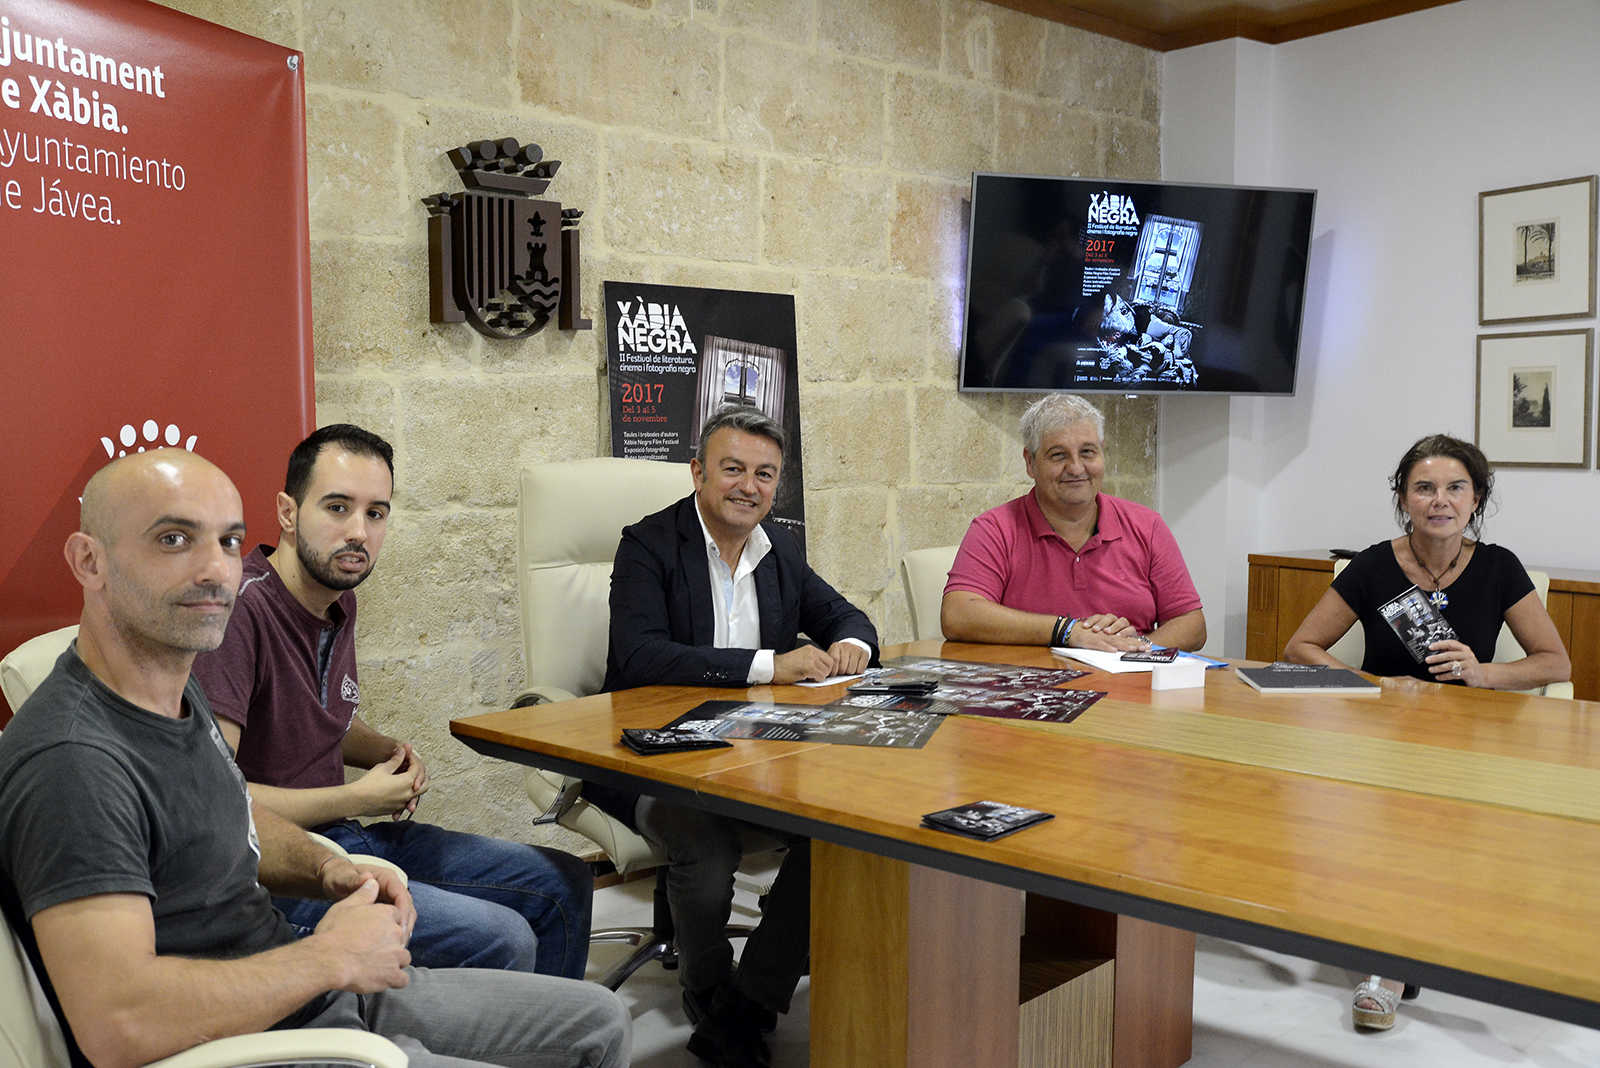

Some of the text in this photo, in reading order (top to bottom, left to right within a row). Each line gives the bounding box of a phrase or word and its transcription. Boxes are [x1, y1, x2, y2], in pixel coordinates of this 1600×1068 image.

[28, 75, 129, 134] Xàbia.
[0, 128, 186, 191] yuntamiento
[33, 176, 122, 225] Jávea.
[1088, 190, 1136, 211] XÀBIA
[1087, 208, 1140, 225] NEGRA
[1086, 239, 1115, 252] 2017
[617, 296, 687, 331] XÀBIA
[618, 327, 697, 354] NEGRA
[619, 353, 695, 365] II Festival de literatura,
[619, 363, 642, 372] cinema
[646, 364, 677, 375] fotografia
[622, 383, 665, 403] 2017
[622, 405, 635, 414] Del
